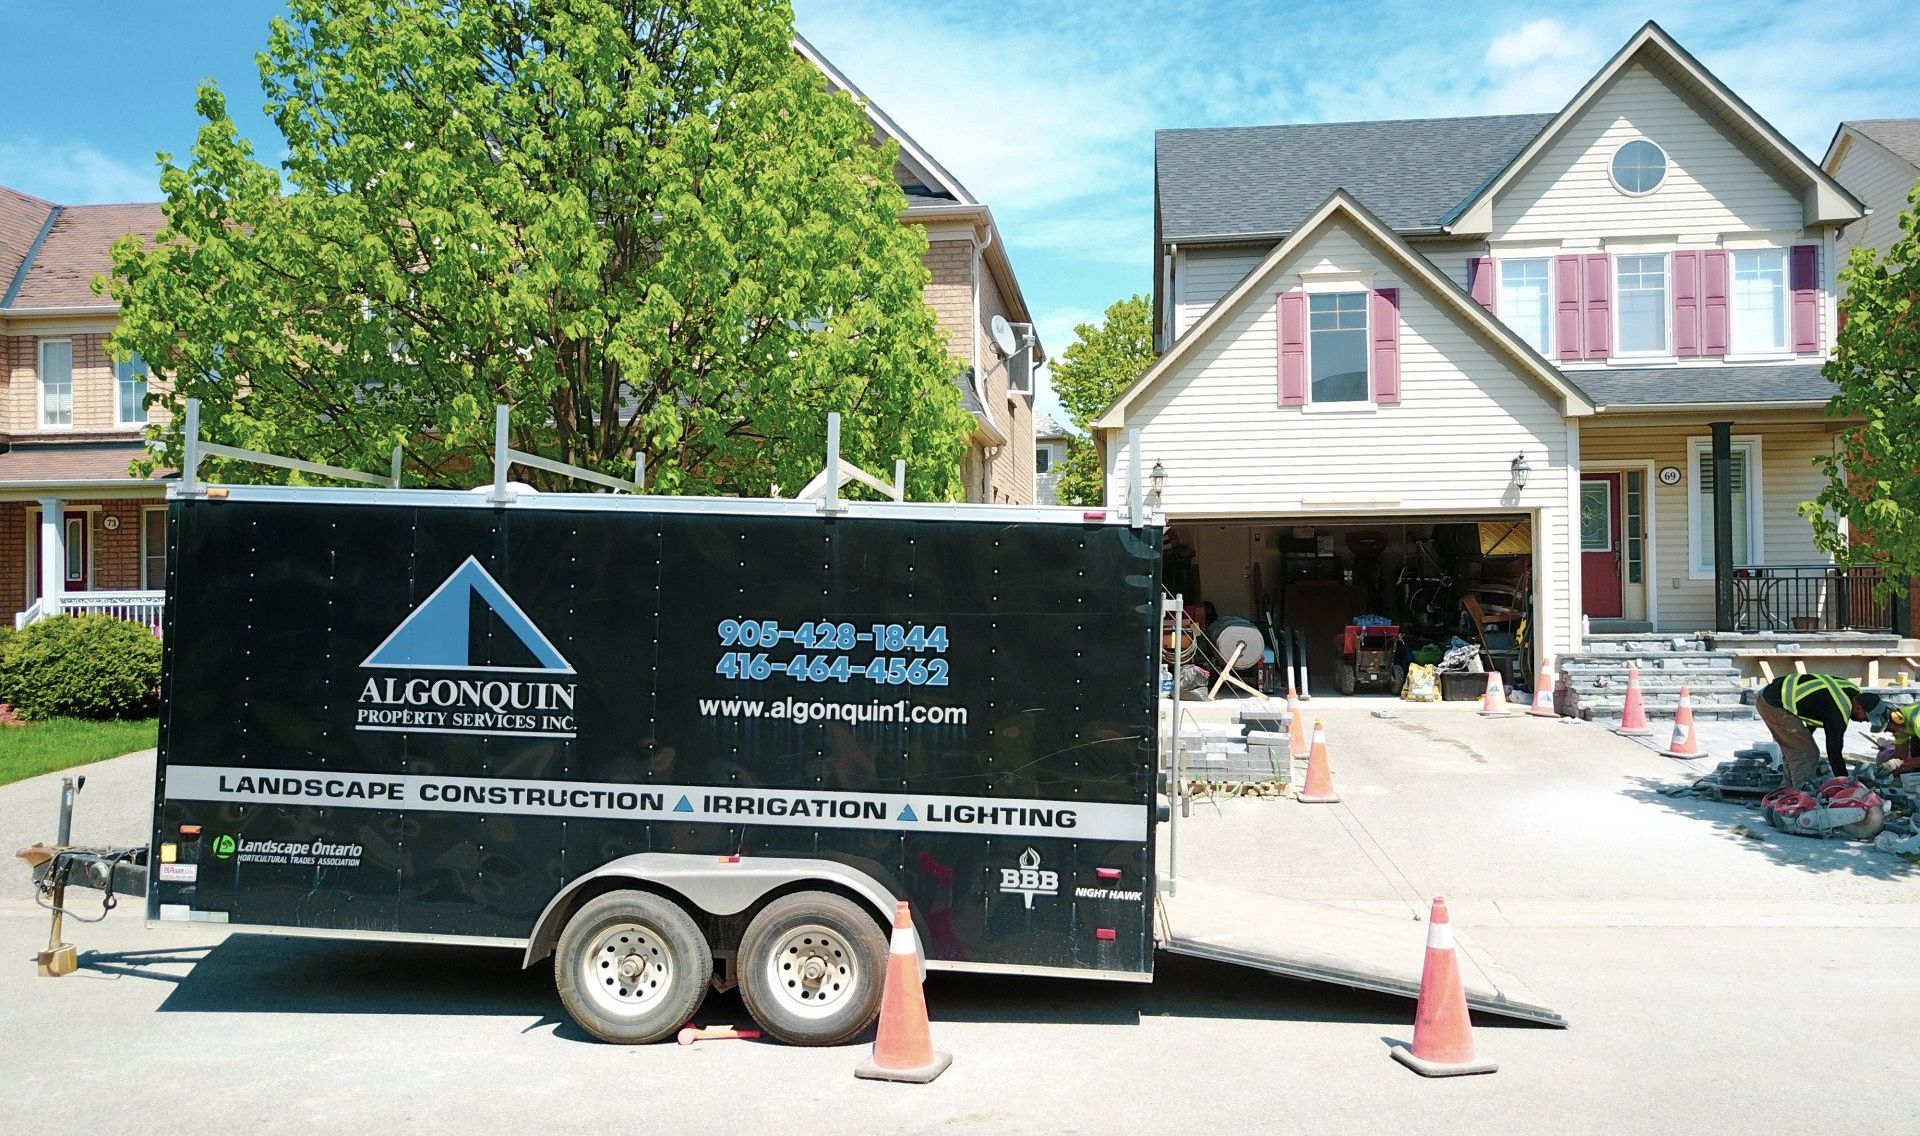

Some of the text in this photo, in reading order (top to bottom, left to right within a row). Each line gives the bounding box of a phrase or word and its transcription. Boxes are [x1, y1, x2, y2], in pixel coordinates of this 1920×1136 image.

[1664, 471, 1676, 481] 69
[107, 519, 117, 527] 73
[717, 618, 950, 653] 905-428-1844
[716, 652, 950, 686] 416-464-4562
[357, 677, 578, 713] ALGONQUIN
[357, 709, 577, 730] PROPERTY SERVICES INC.
[699, 697, 968, 726] www.algonquin1.com
[219, 775, 1077, 829] LANDSCAPE CONSTRUCTION IRRIGATION LIGHTING
[237, 838, 363, 857] Landscape Ontario
[237, 854, 361, 867] HORTICULTURAL TRADES ASSOCIATION
[1000, 868, 1059, 890] BBB
[1075, 887, 1143, 901] NIGHT HAWK
